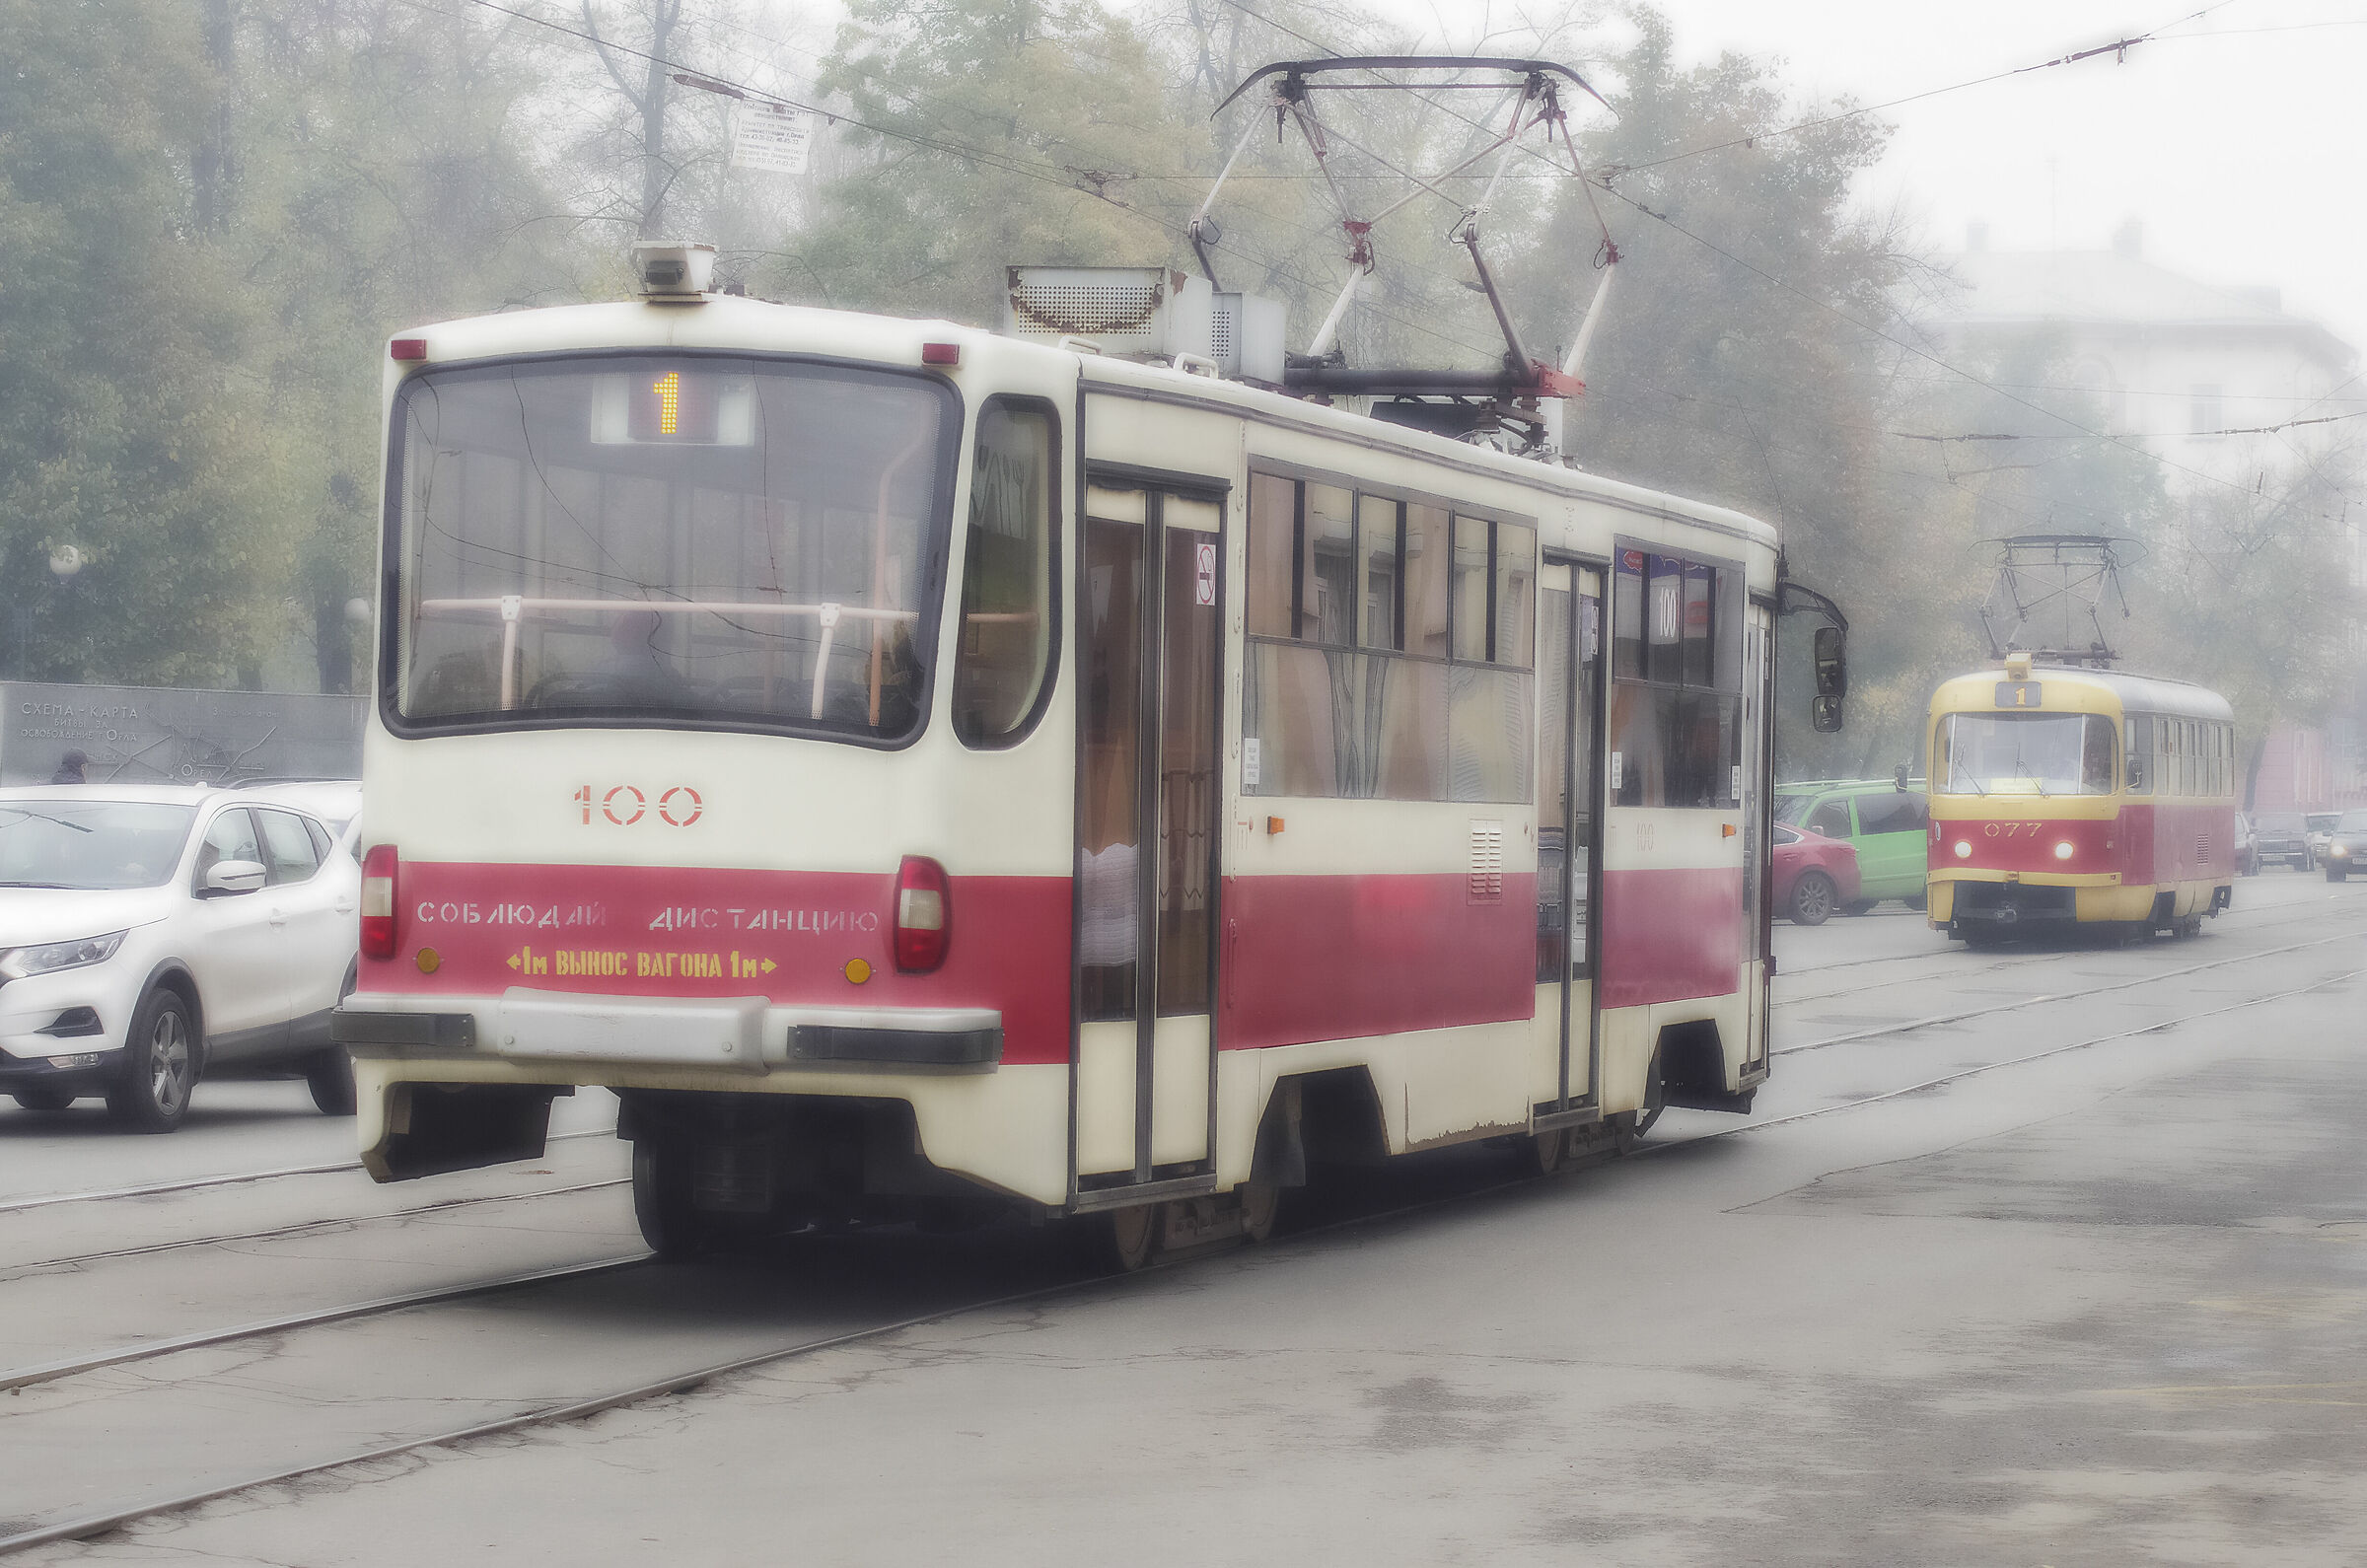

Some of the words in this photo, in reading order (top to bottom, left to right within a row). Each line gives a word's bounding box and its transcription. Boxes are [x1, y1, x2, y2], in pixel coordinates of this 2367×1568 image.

[653, 372, 680, 435] 1
[1659, 587, 1678, 638] 100
[2015, 686, 2026, 706] 1
[22, 702, 74, 716] СХЕМА
[90, 703, 138, 720] КАРТА
[54, 718, 86, 728] БИТВЫ
[95, 719, 108, 729] ЗА
[22, 729, 94, 740] ОСВОБОЖДЕНИЕ
[574, 784, 703, 827] 100
[1984, 821, 2043, 838] 077
[417, 901, 607, 929] СОБЛЮДАЙ
[648, 906, 879, 935] ДИСТАНЦИЮ
[523, 946, 548, 975] 1м
[555, 950, 628, 976] ВЫНОС
[636, 952, 723, 977] ВАГОНА
[730, 950, 757, 978] 1м
